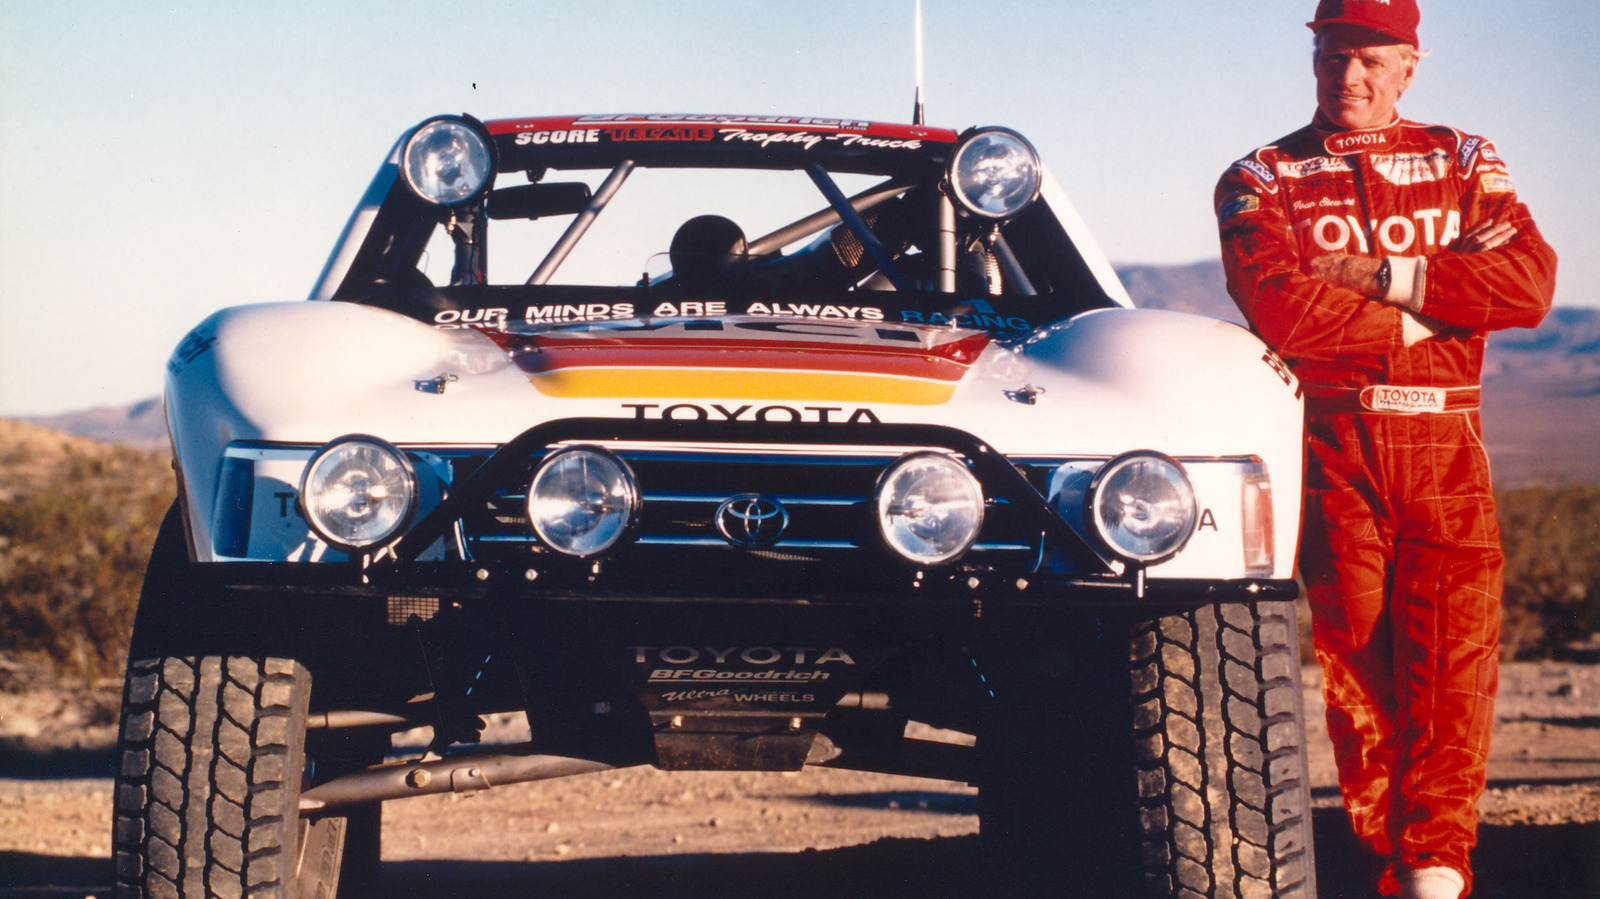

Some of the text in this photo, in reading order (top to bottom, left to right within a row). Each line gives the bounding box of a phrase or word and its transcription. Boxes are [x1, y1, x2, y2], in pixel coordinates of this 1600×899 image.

[514, 129, 600, 146] SCORE
[1336, 132, 1387, 149] TOYOTA
[1284, 156, 1343, 173] TOYOTA
[434, 301, 1032, 331] OUR MINDS ARE ALWAYS RACING
[1382, 388, 1437, 403] TOYOTA
[621, 403, 882, 424] TOYOTA
[625, 646, 856, 665] TOYOTA
[650, 669, 831, 681] BFGoodrich
[733, 693, 815, 702] WHEELS
